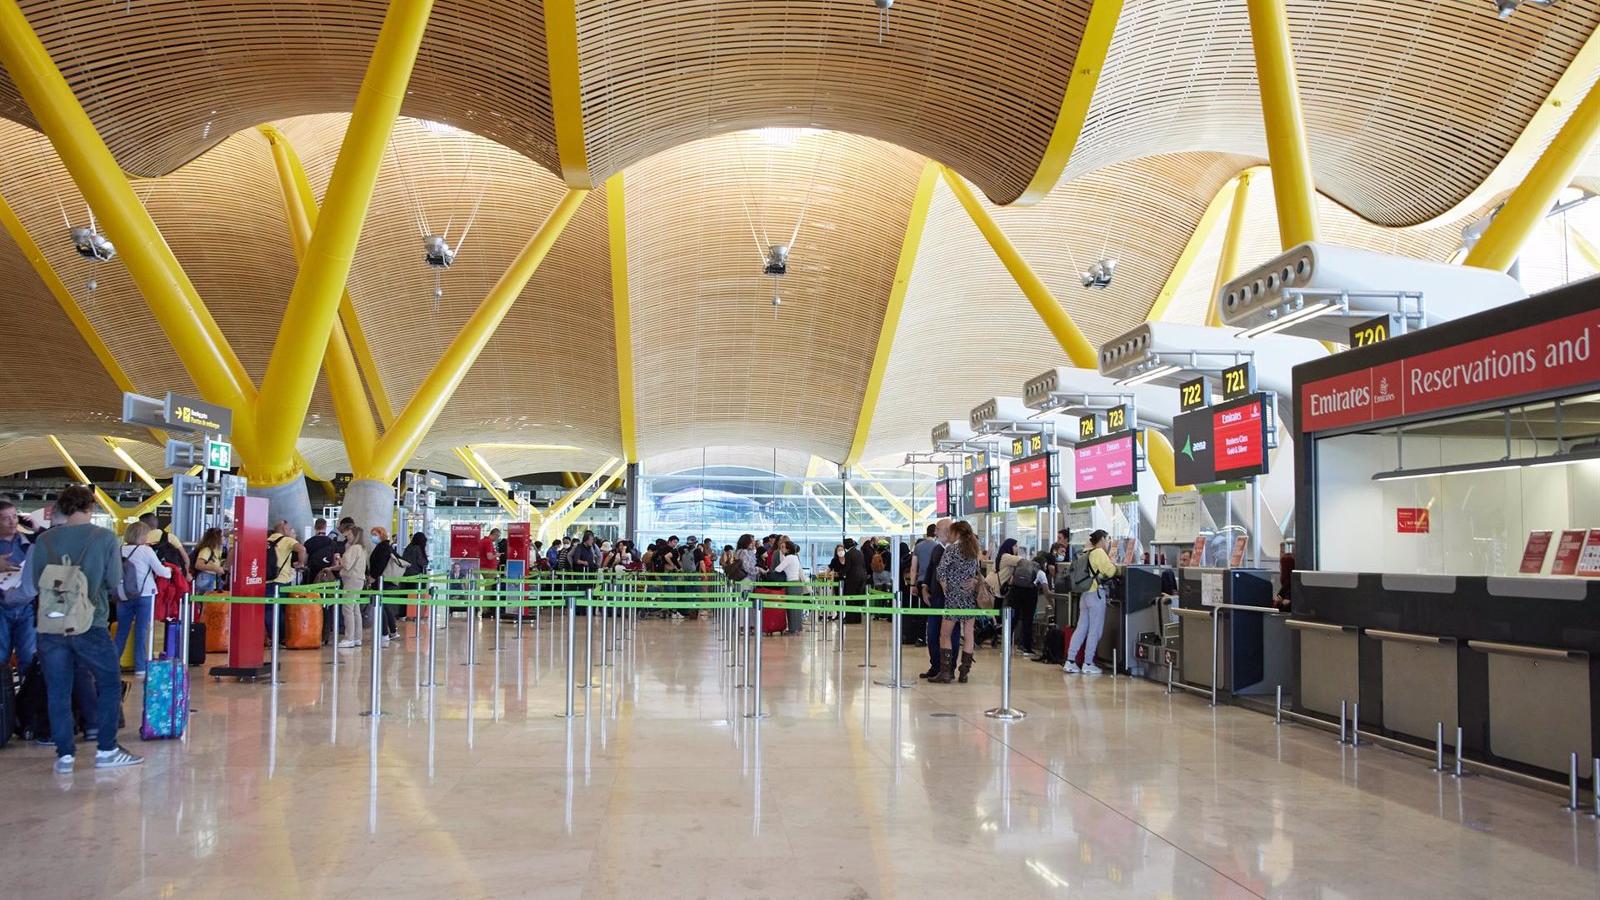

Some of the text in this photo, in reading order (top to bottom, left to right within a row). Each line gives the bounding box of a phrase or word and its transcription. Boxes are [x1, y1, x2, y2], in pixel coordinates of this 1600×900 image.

[1354, 324, 1386, 347] 720
[1410, 328, 1591, 396] Reservations and
[1225, 368, 1245, 394] 721
[1182, 383, 1202, 407] 722
[1310, 385, 1371, 416] Emirates
[1373, 393, 1396, 404] Emirates
[1080, 418, 1094, 437] 724
[1108, 409, 1124, 428] 723
[1221, 412, 1242, 424] Emirates
[1013, 441, 1023, 456] 726
[1031, 435, 1041, 451] 725
